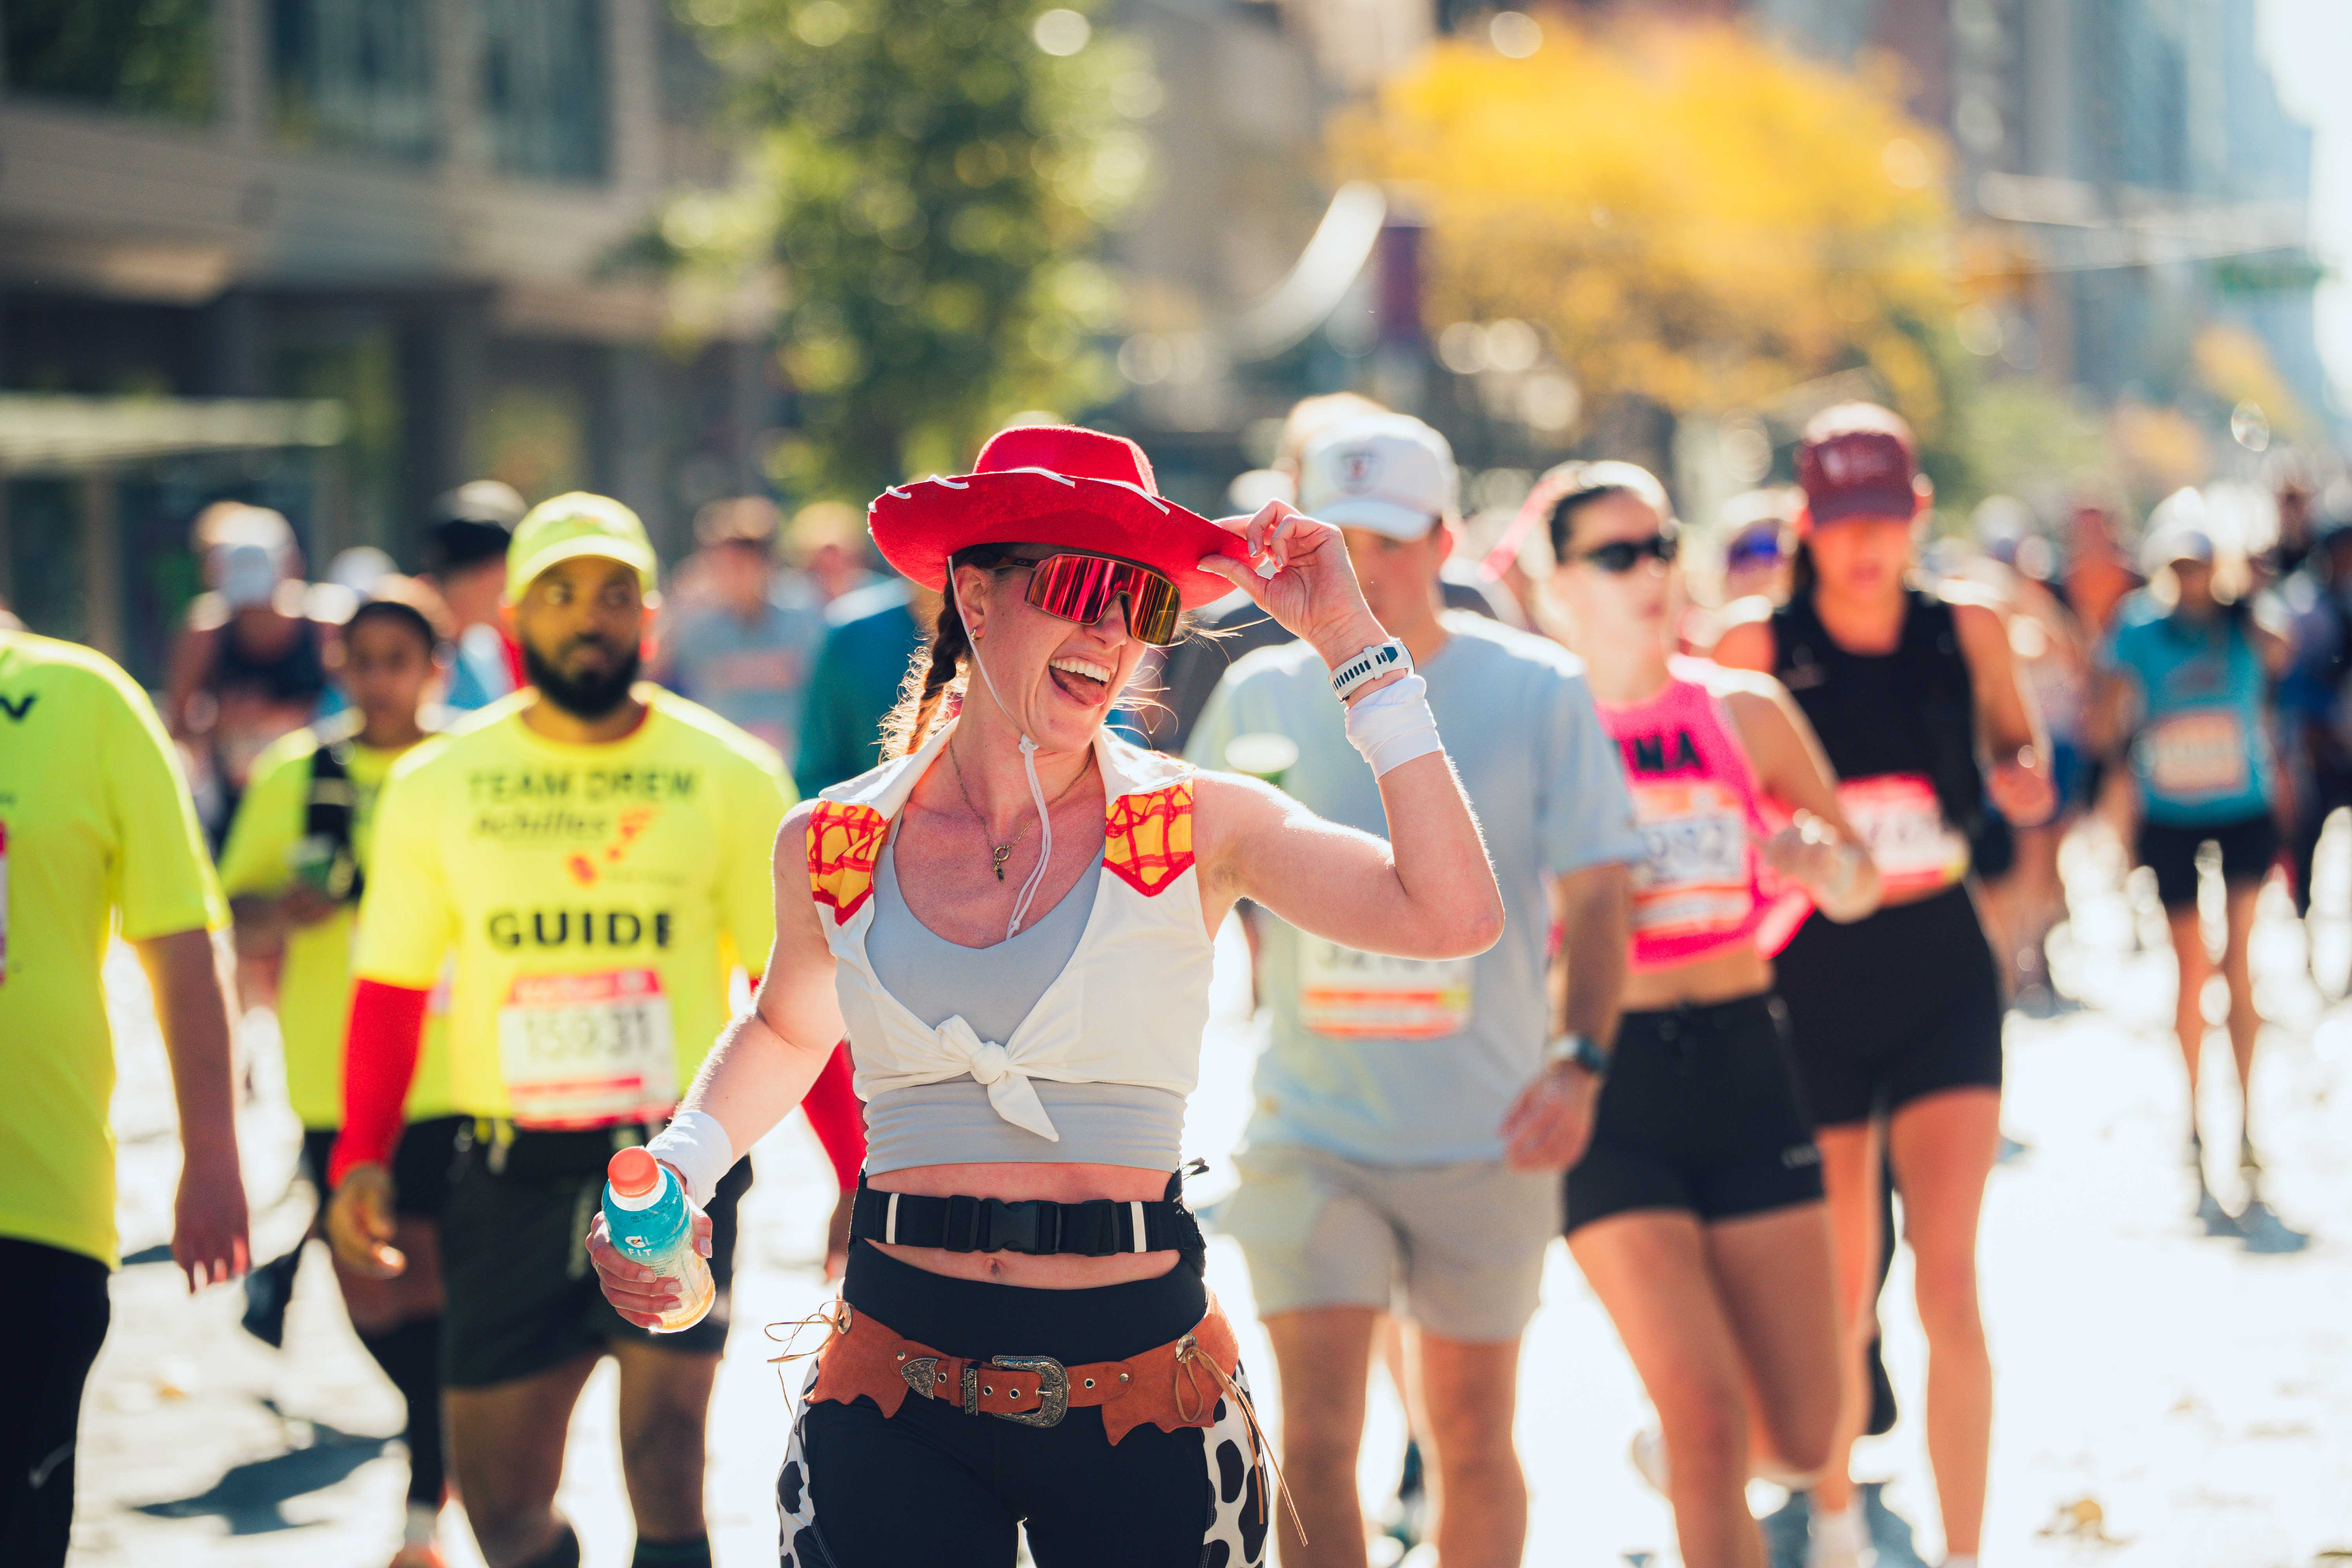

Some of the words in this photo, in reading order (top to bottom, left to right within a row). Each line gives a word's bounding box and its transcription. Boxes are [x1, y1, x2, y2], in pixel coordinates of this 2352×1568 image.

[469, 769, 569, 802] TEAM
[588, 767, 698, 800] DREW
[475, 806, 607, 840] Achilles
[488, 911, 676, 949] GUIDE
[524, 1008, 653, 1060] 15931
[628, 1248, 652, 1257] FIT
